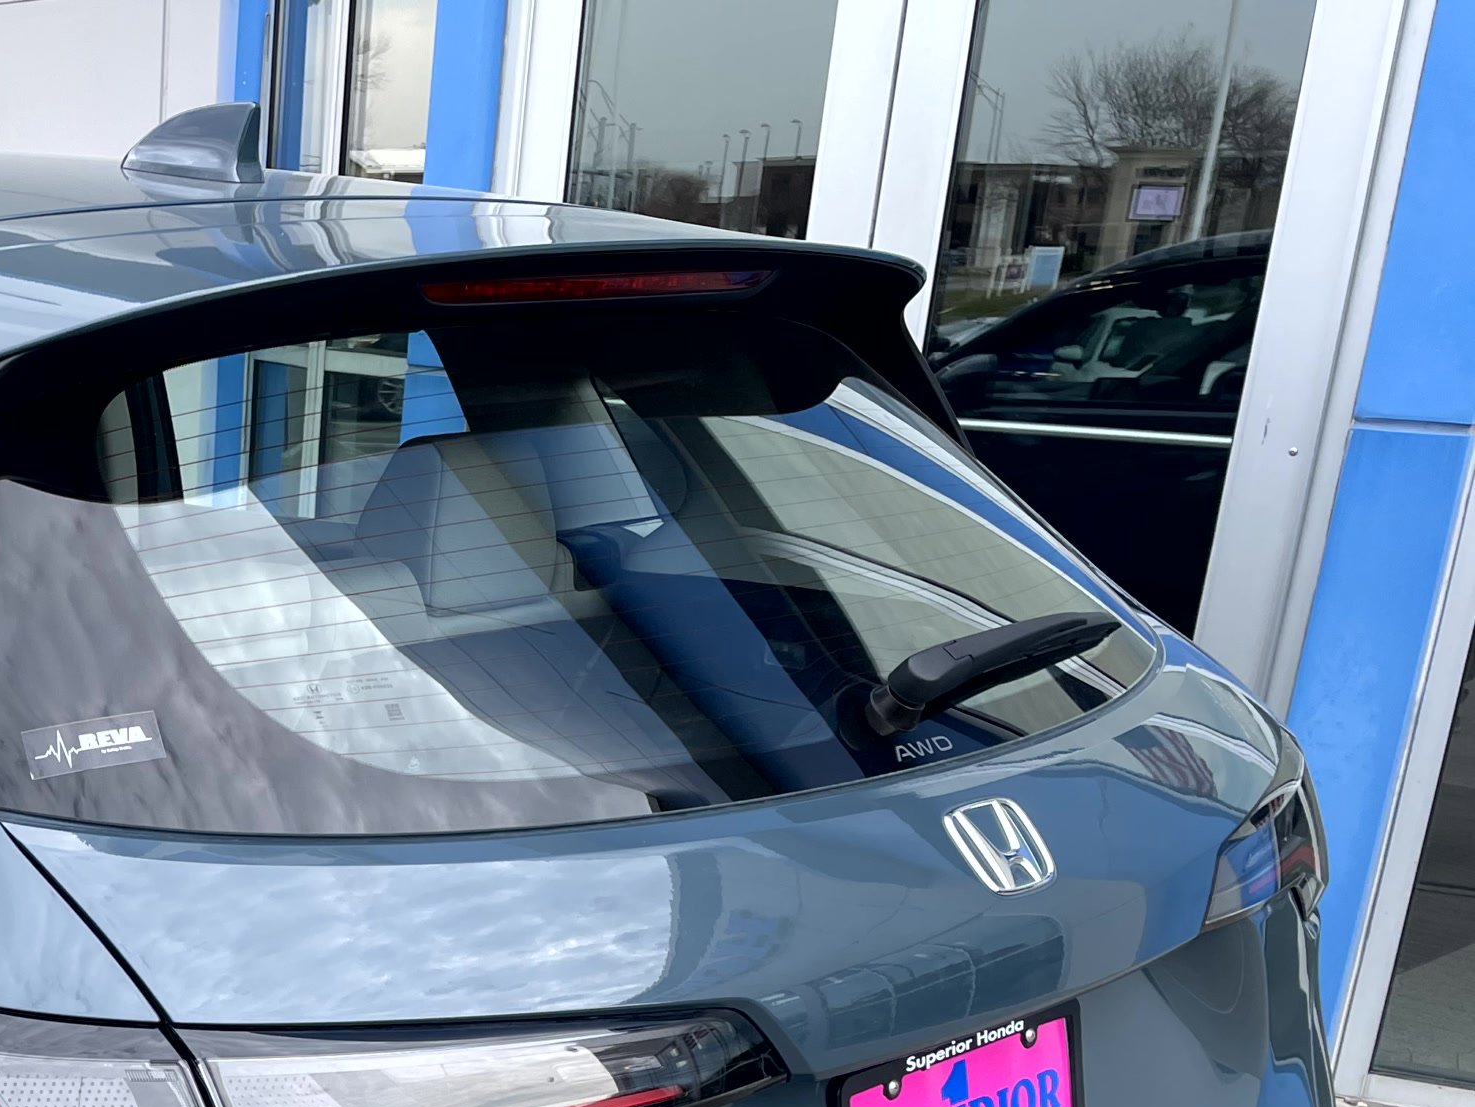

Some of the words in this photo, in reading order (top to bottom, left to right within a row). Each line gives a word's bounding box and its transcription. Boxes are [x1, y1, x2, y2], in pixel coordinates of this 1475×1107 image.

[894, 735, 953, 762] AWD
[905, 1039, 973, 1072] Superior
[976, 1019, 1025, 1047] Honda
